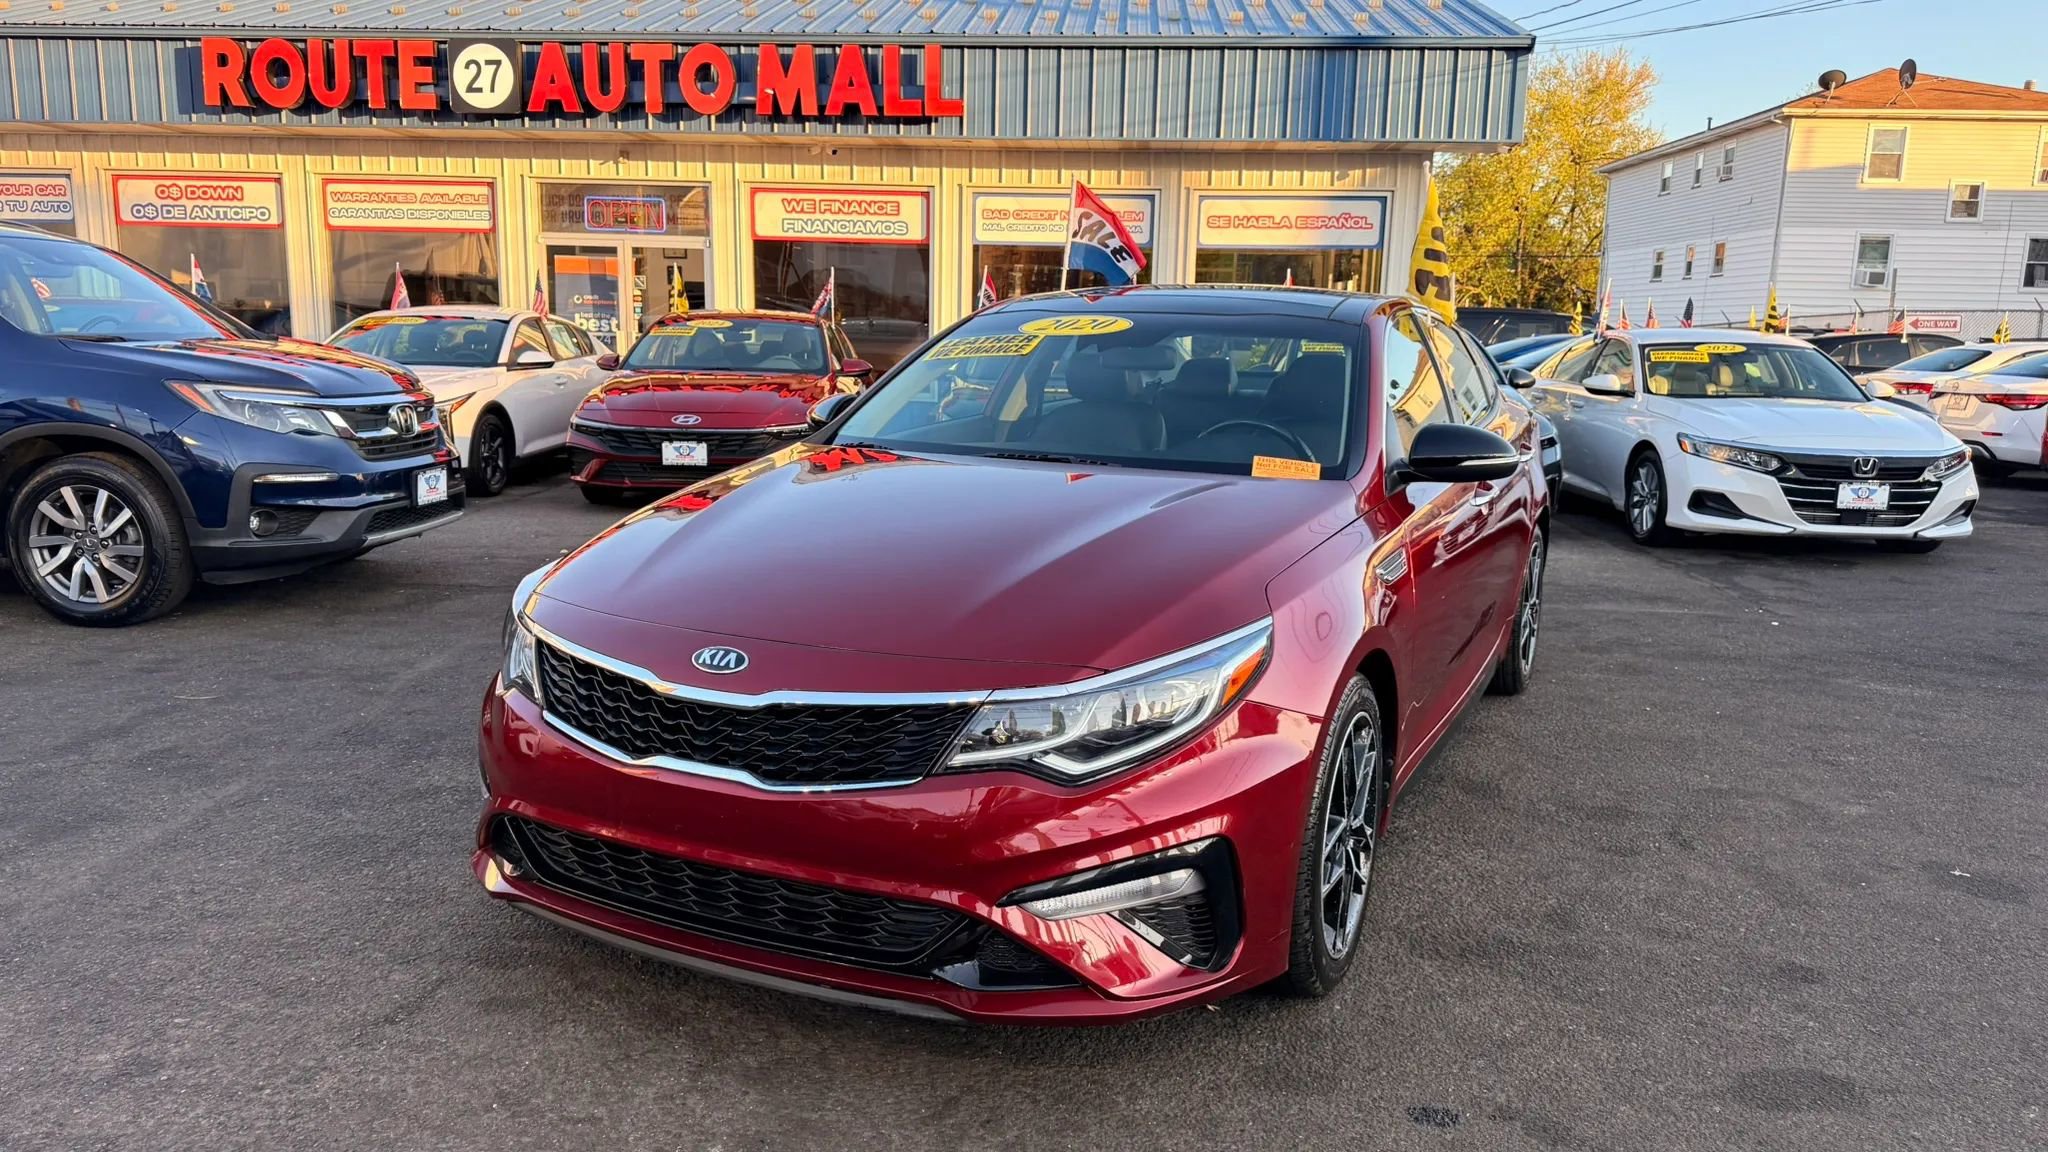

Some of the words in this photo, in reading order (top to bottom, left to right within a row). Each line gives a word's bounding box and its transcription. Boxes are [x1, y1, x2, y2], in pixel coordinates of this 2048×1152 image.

[201, 36, 439, 109] ROUTE
[464, 59, 501, 94] 27
[527, 42, 736, 115] AUTO
[757, 43, 964, 116] MALL
[35, 184, 66, 196] CAR
[185, 185, 243, 200] DOWN
[330, 191, 416, 203] WARRANTIES
[417, 193, 488, 204] AVAILABLE
[6, 200, 27, 212] TU
[31, 200, 71, 212] AUTO
[161, 205, 187, 219] DE
[189, 205, 270, 221] ANTICIPO
[782, 198, 816, 213] WE
[819, 199, 900, 216] FINANCE
[329, 207, 405, 219] GARANTIAS
[406, 209, 491, 221] DISPONIBLES
[588, 200, 664, 229] OPEN
[982, 209, 1010, 219] BAD
[1012, 210, 1058, 220] CREDIT
[1207, 216, 1232, 228] SE
[1233, 216, 1293, 229] HABLA
[1295, 213, 1373, 229] ESPAÑOL
[782, 218, 908, 235] FINANCIAMOS
[982, 223, 1005, 231] MAL
[1007, 223, 1048, 232] CREDITO
[1049, 224, 1064, 232] NO
[1072, 211, 1133, 263] SALE
[1034, 319, 1118, 331] 2020
[941, 334, 1040, 347] LEATHER
[958, 343, 1030, 357] FINANCE
[699, 649, 737, 668] KIA
